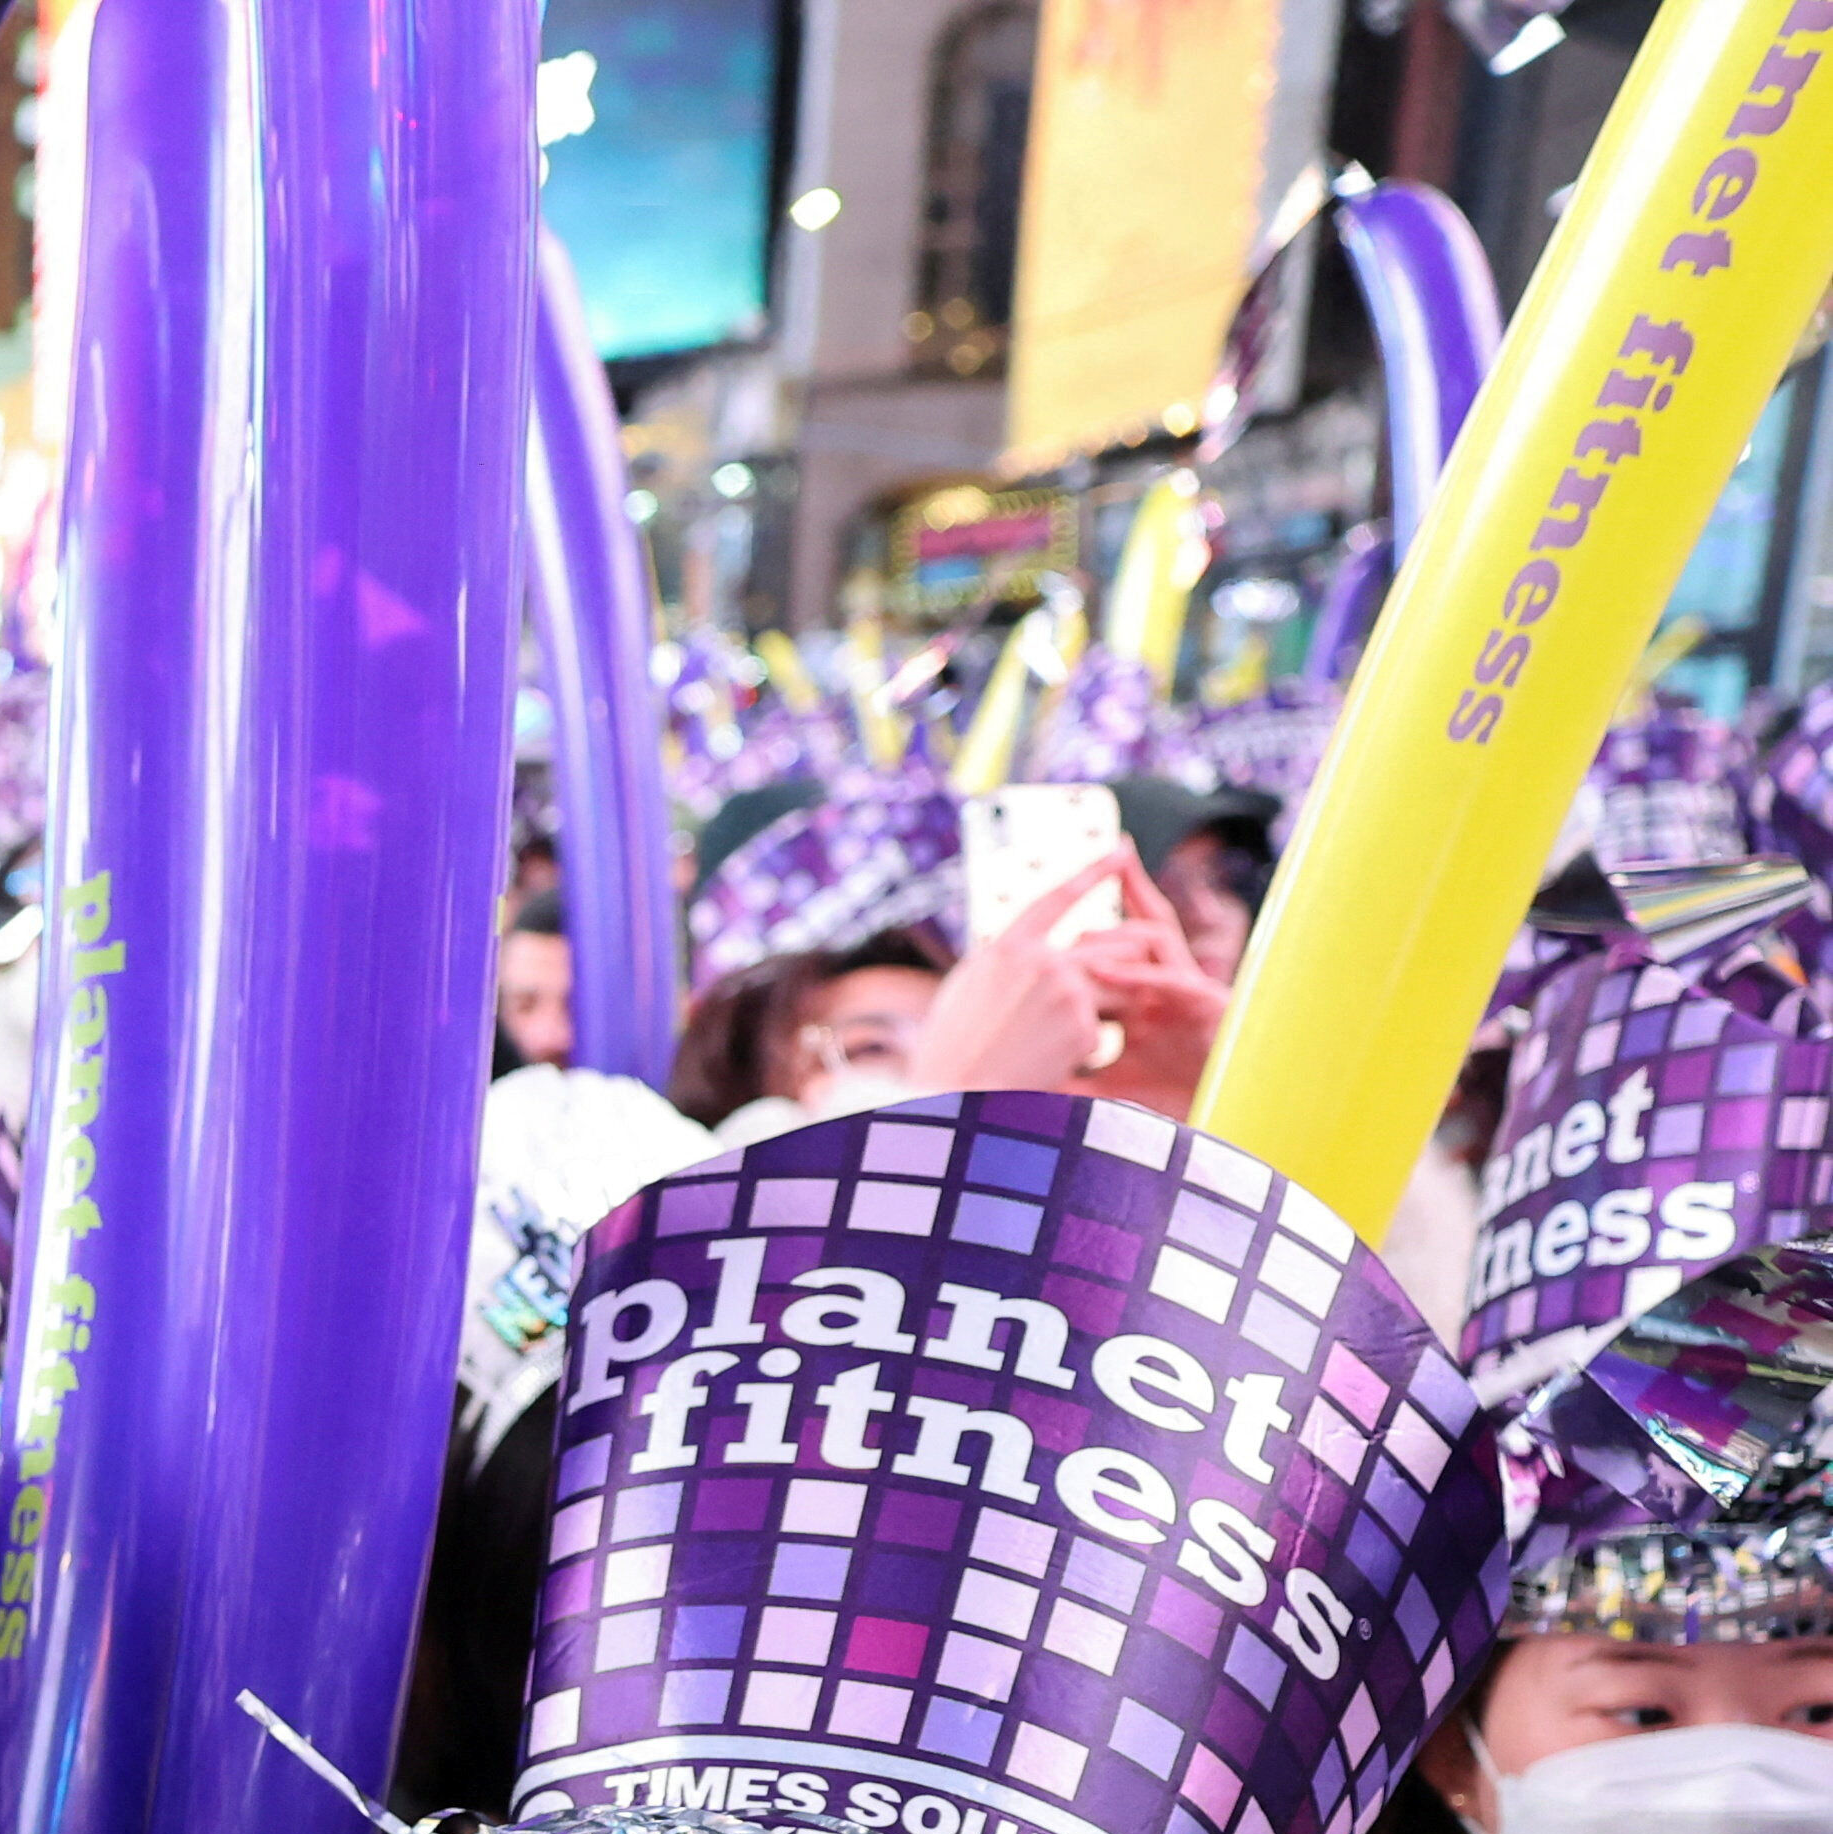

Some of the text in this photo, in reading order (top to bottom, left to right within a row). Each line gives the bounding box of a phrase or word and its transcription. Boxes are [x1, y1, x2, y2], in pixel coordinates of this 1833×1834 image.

[1447, 313, 1695, 746] fitness
[54, 870, 125, 1250] planet
[567, 1237, 1293, 1485] planet
[630, 1347, 1354, 1681] fitness
[604, 1766, 831, 1816] TIMES
